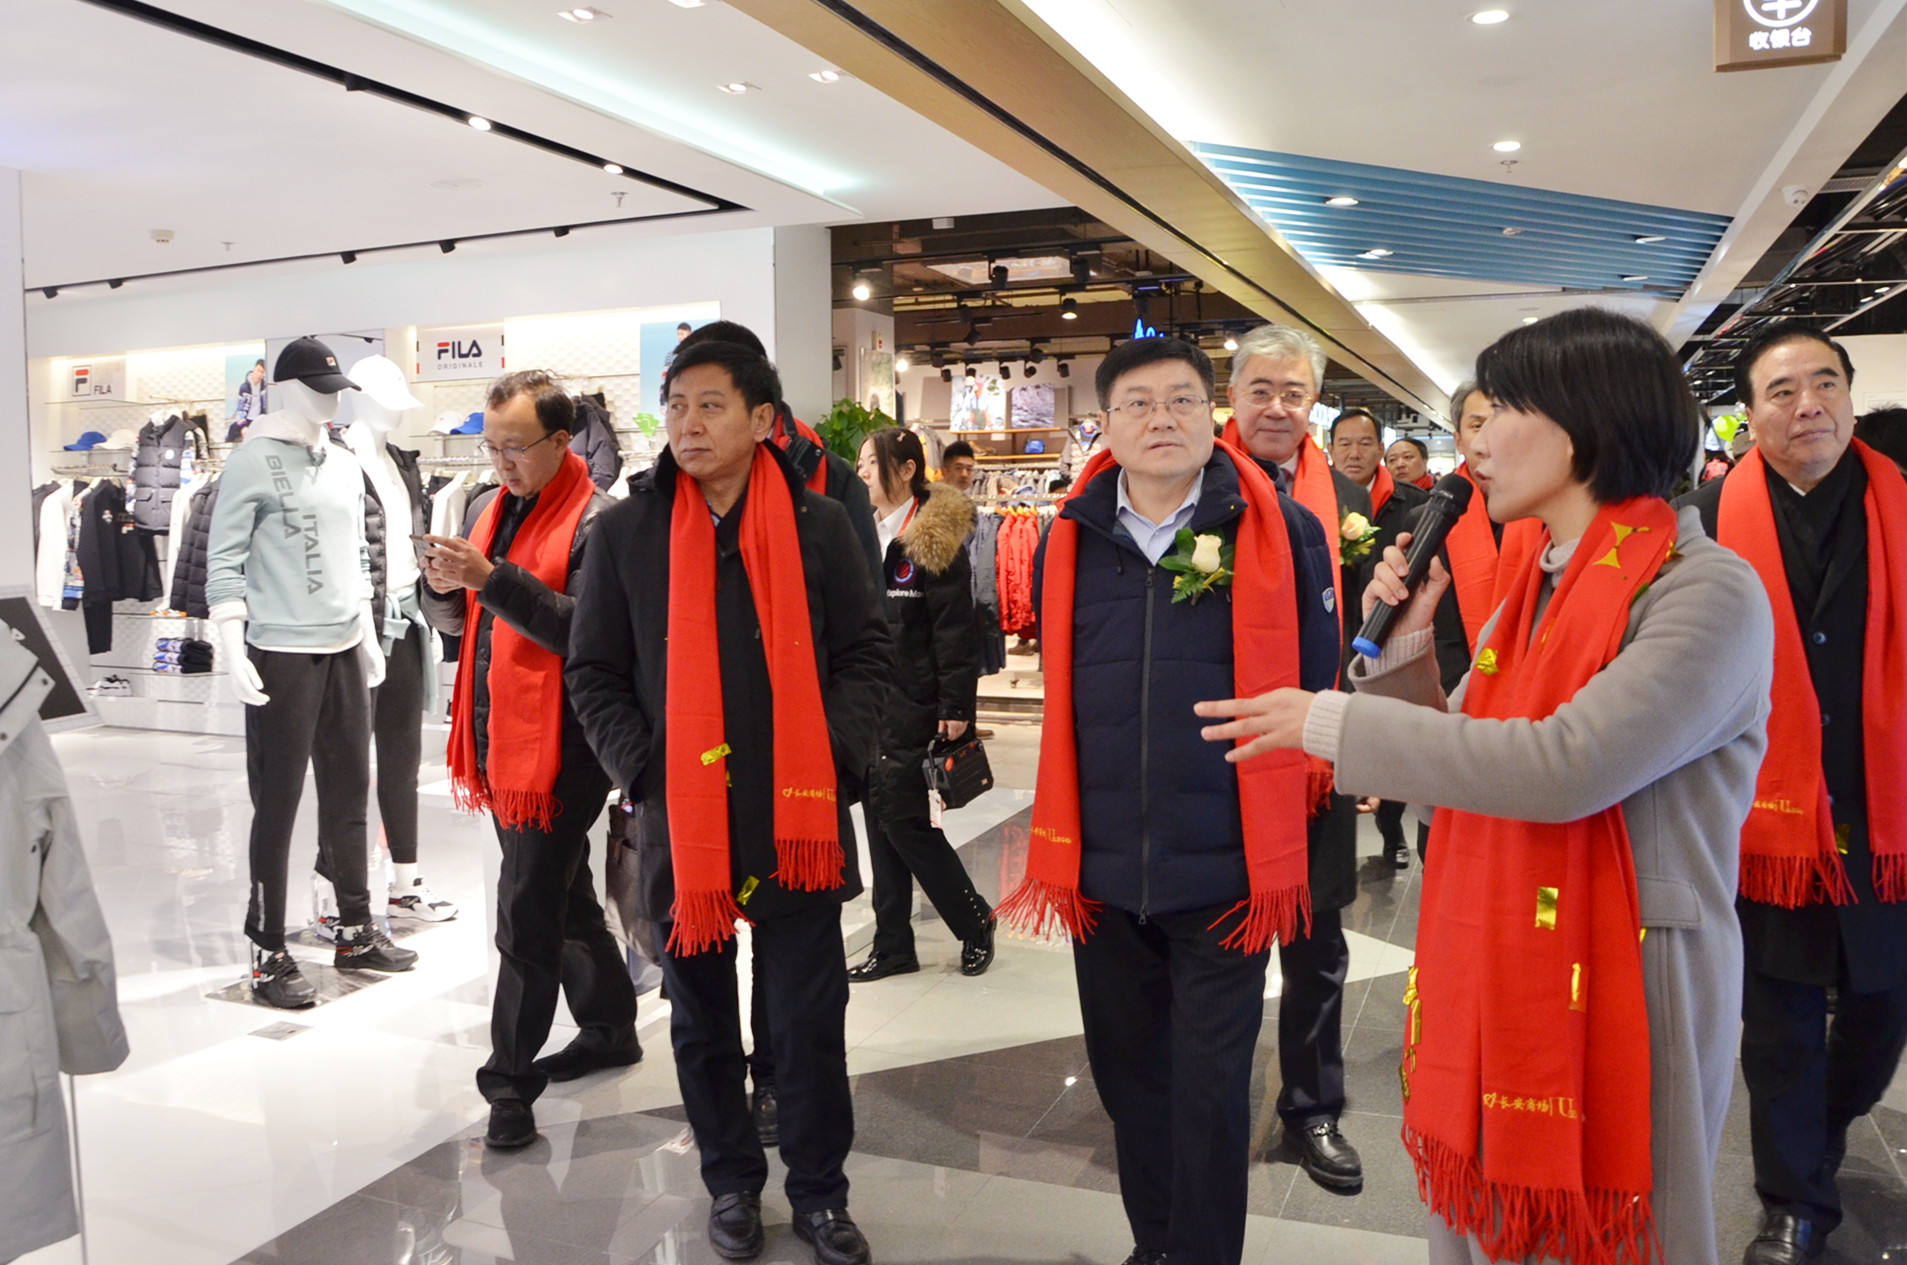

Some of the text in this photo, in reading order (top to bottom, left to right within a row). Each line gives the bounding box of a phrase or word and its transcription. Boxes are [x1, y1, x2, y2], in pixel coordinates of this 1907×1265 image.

[1749, 27, 1812, 51] 收银台
[437, 339, 483, 360] FILA
[437, 361, 484, 370] ORIGINALE
[265, 455, 302, 539] BIELLA
[302, 514, 324, 595] ITALIA
